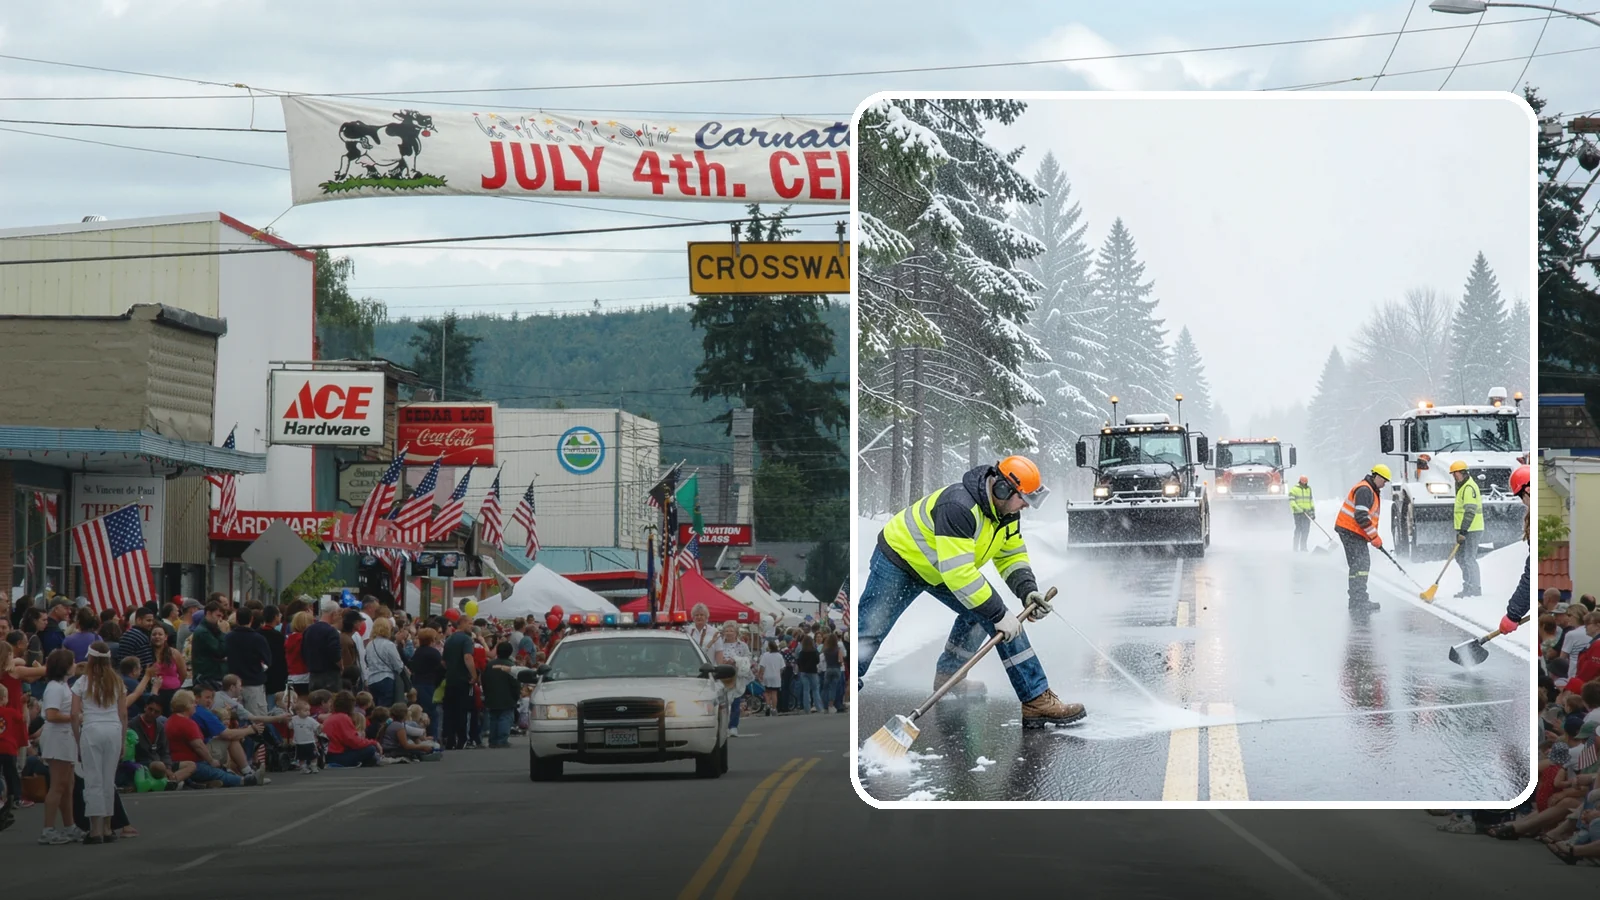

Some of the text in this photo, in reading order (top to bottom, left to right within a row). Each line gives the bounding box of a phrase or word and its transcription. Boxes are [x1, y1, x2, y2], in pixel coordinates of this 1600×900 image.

[695, 121, 850, 150] Carnat
[481, 141, 605, 193] JULY
[632, 150, 746, 198] 4th.
[697, 254, 850, 280] CROSSWA
[283, 380, 373, 420] ACE
[406, 409, 485, 422] CEDAR LOG
[283, 421, 370, 437] Hardware
[416, 428, 477, 447] Coca-Cola
[83, 485, 155, 495] St. Vincent de Paul
[688, 526, 741, 535] CRNATION
[699, 535, 730, 543] GLASS
